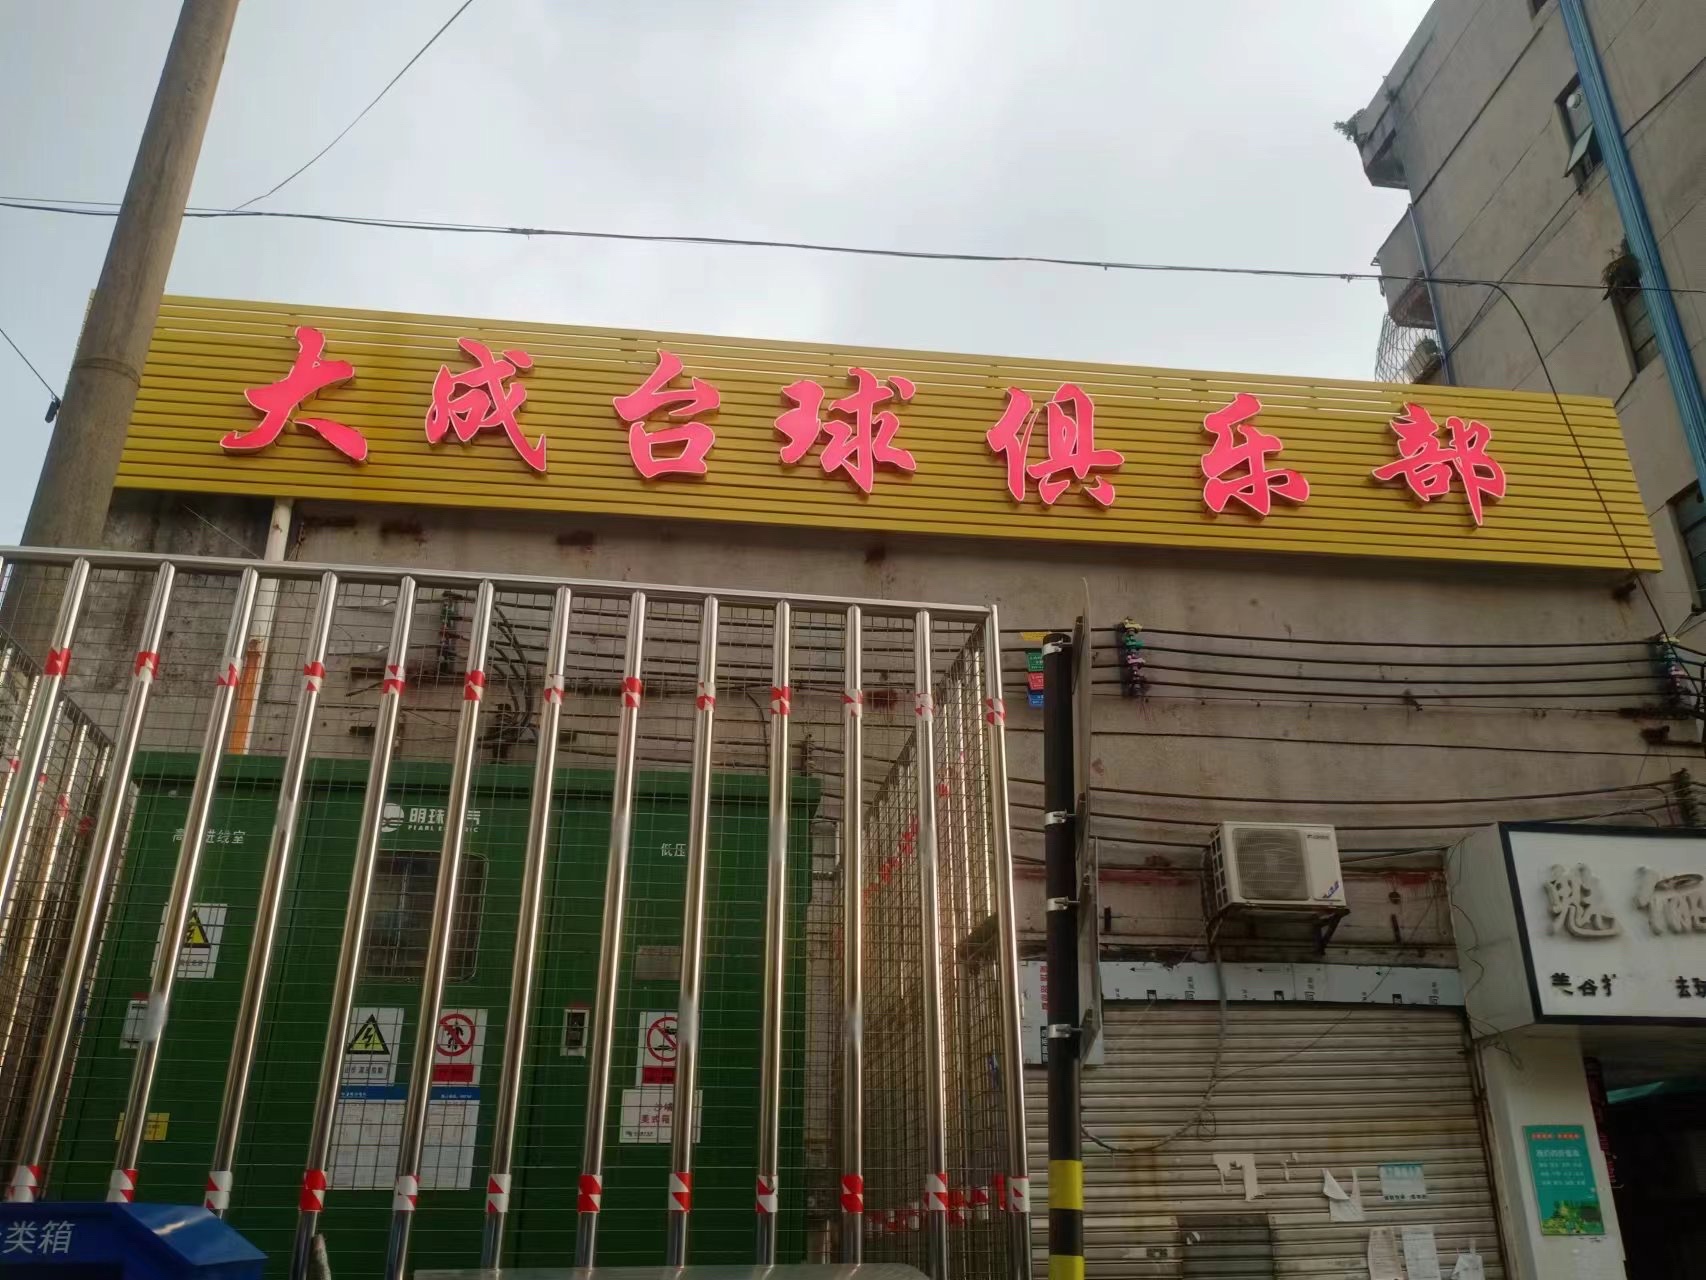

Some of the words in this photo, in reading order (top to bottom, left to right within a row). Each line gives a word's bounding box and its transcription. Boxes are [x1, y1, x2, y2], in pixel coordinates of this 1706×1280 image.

[219, 325, 1508, 527] 大成台球俱乐部
[409, 807, 481, 825] 明球气
[172, 828, 246, 844] 高进线室
[0, 1220, 75, 1254] 类箱
